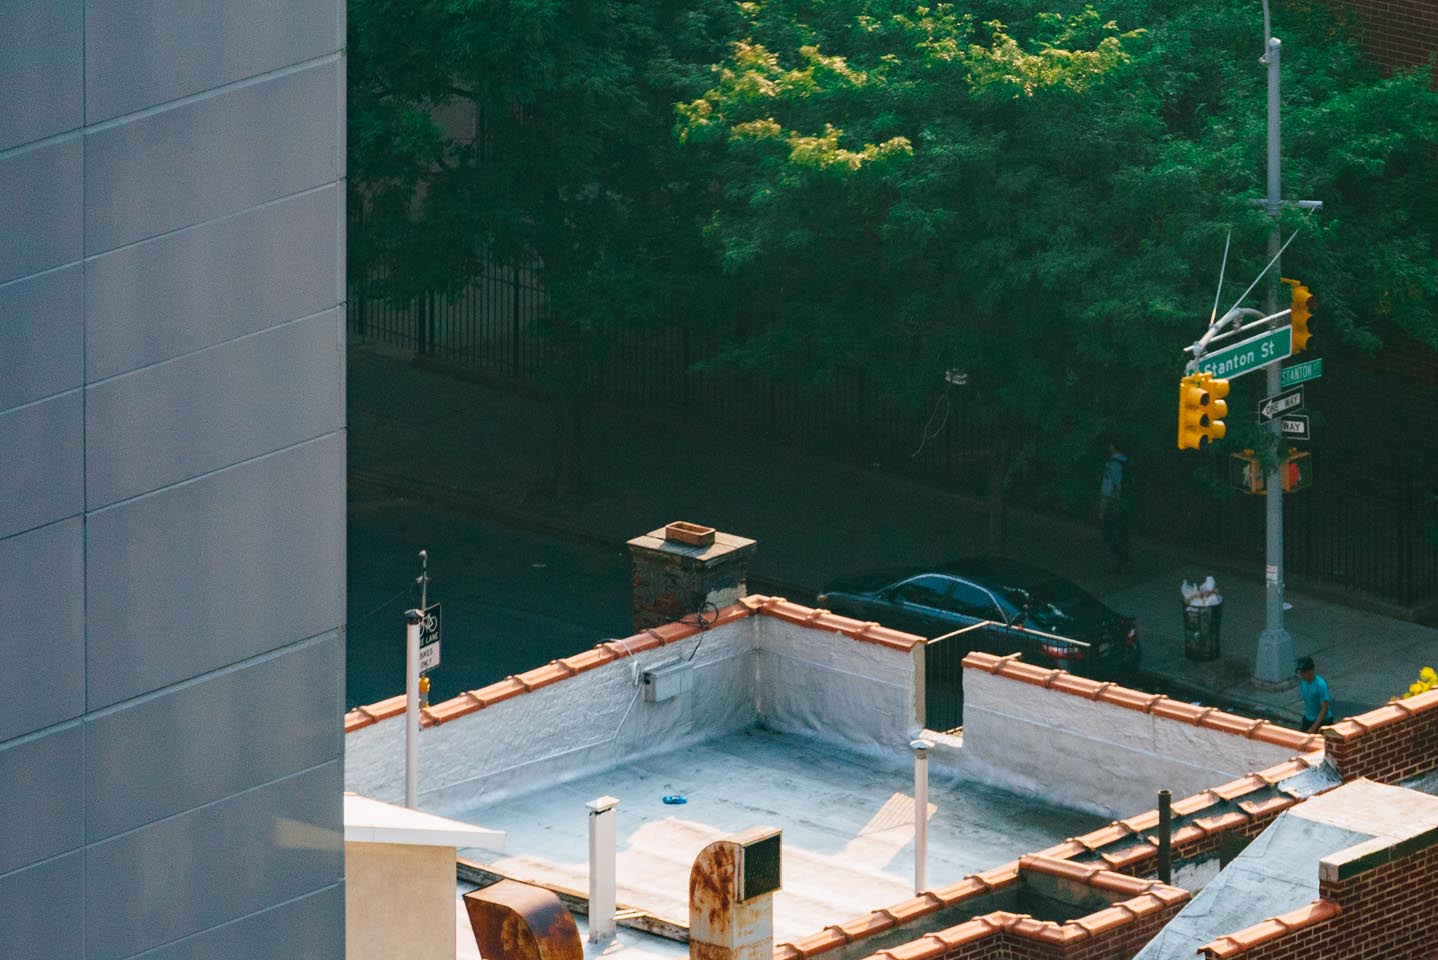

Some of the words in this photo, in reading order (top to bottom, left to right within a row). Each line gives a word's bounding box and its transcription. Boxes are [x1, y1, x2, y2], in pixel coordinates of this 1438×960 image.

[1204, 351, 1255, 378] Stanton
[1261, 340, 1275, 358] St
[1282, 364, 1312, 382] STANTON
[1266, 402, 1279, 416] ONE
[1284, 394, 1298, 409] WAY
[1283, 422, 1301, 432] WAY
